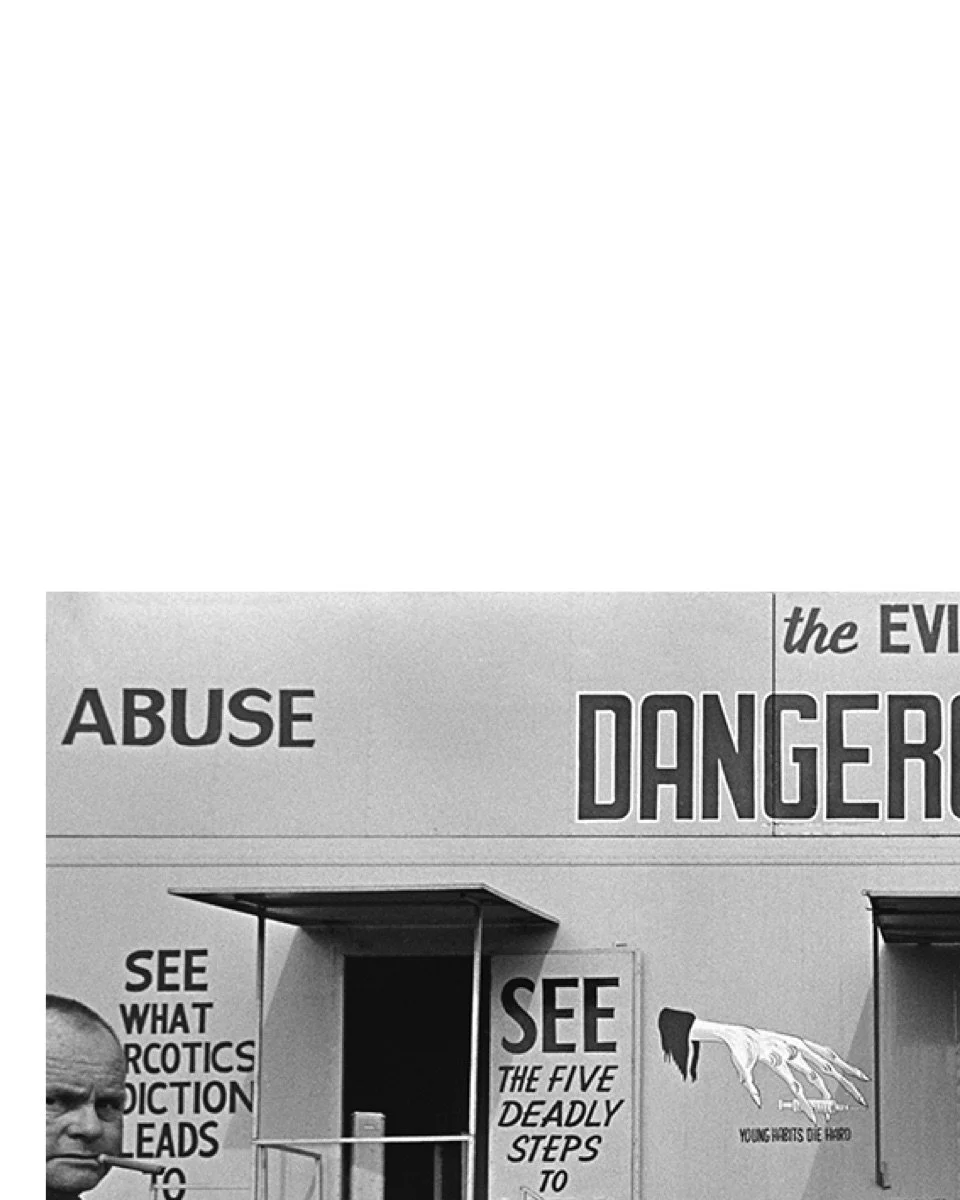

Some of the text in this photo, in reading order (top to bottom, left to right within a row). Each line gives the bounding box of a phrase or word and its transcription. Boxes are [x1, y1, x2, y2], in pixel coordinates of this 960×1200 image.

[783, 606, 858, 655] the
[61, 687, 317, 748] ABUSE
[125, 949, 208, 992] SEE
[119, 1002, 213, 1034] WHAT
[500, 977, 620, 1053] SEE
[499, 1065, 618, 1093] THE FIVE
[498, 1100, 624, 1127] DEADLY
[507, 1135, 602, 1162] STEPS
[739, 1127, 770, 1143] YOUNG
[806, 1127, 822, 1143] DIE
[825, 1127, 852, 1142] HARD
[539, 1169, 568, 1193] TO
